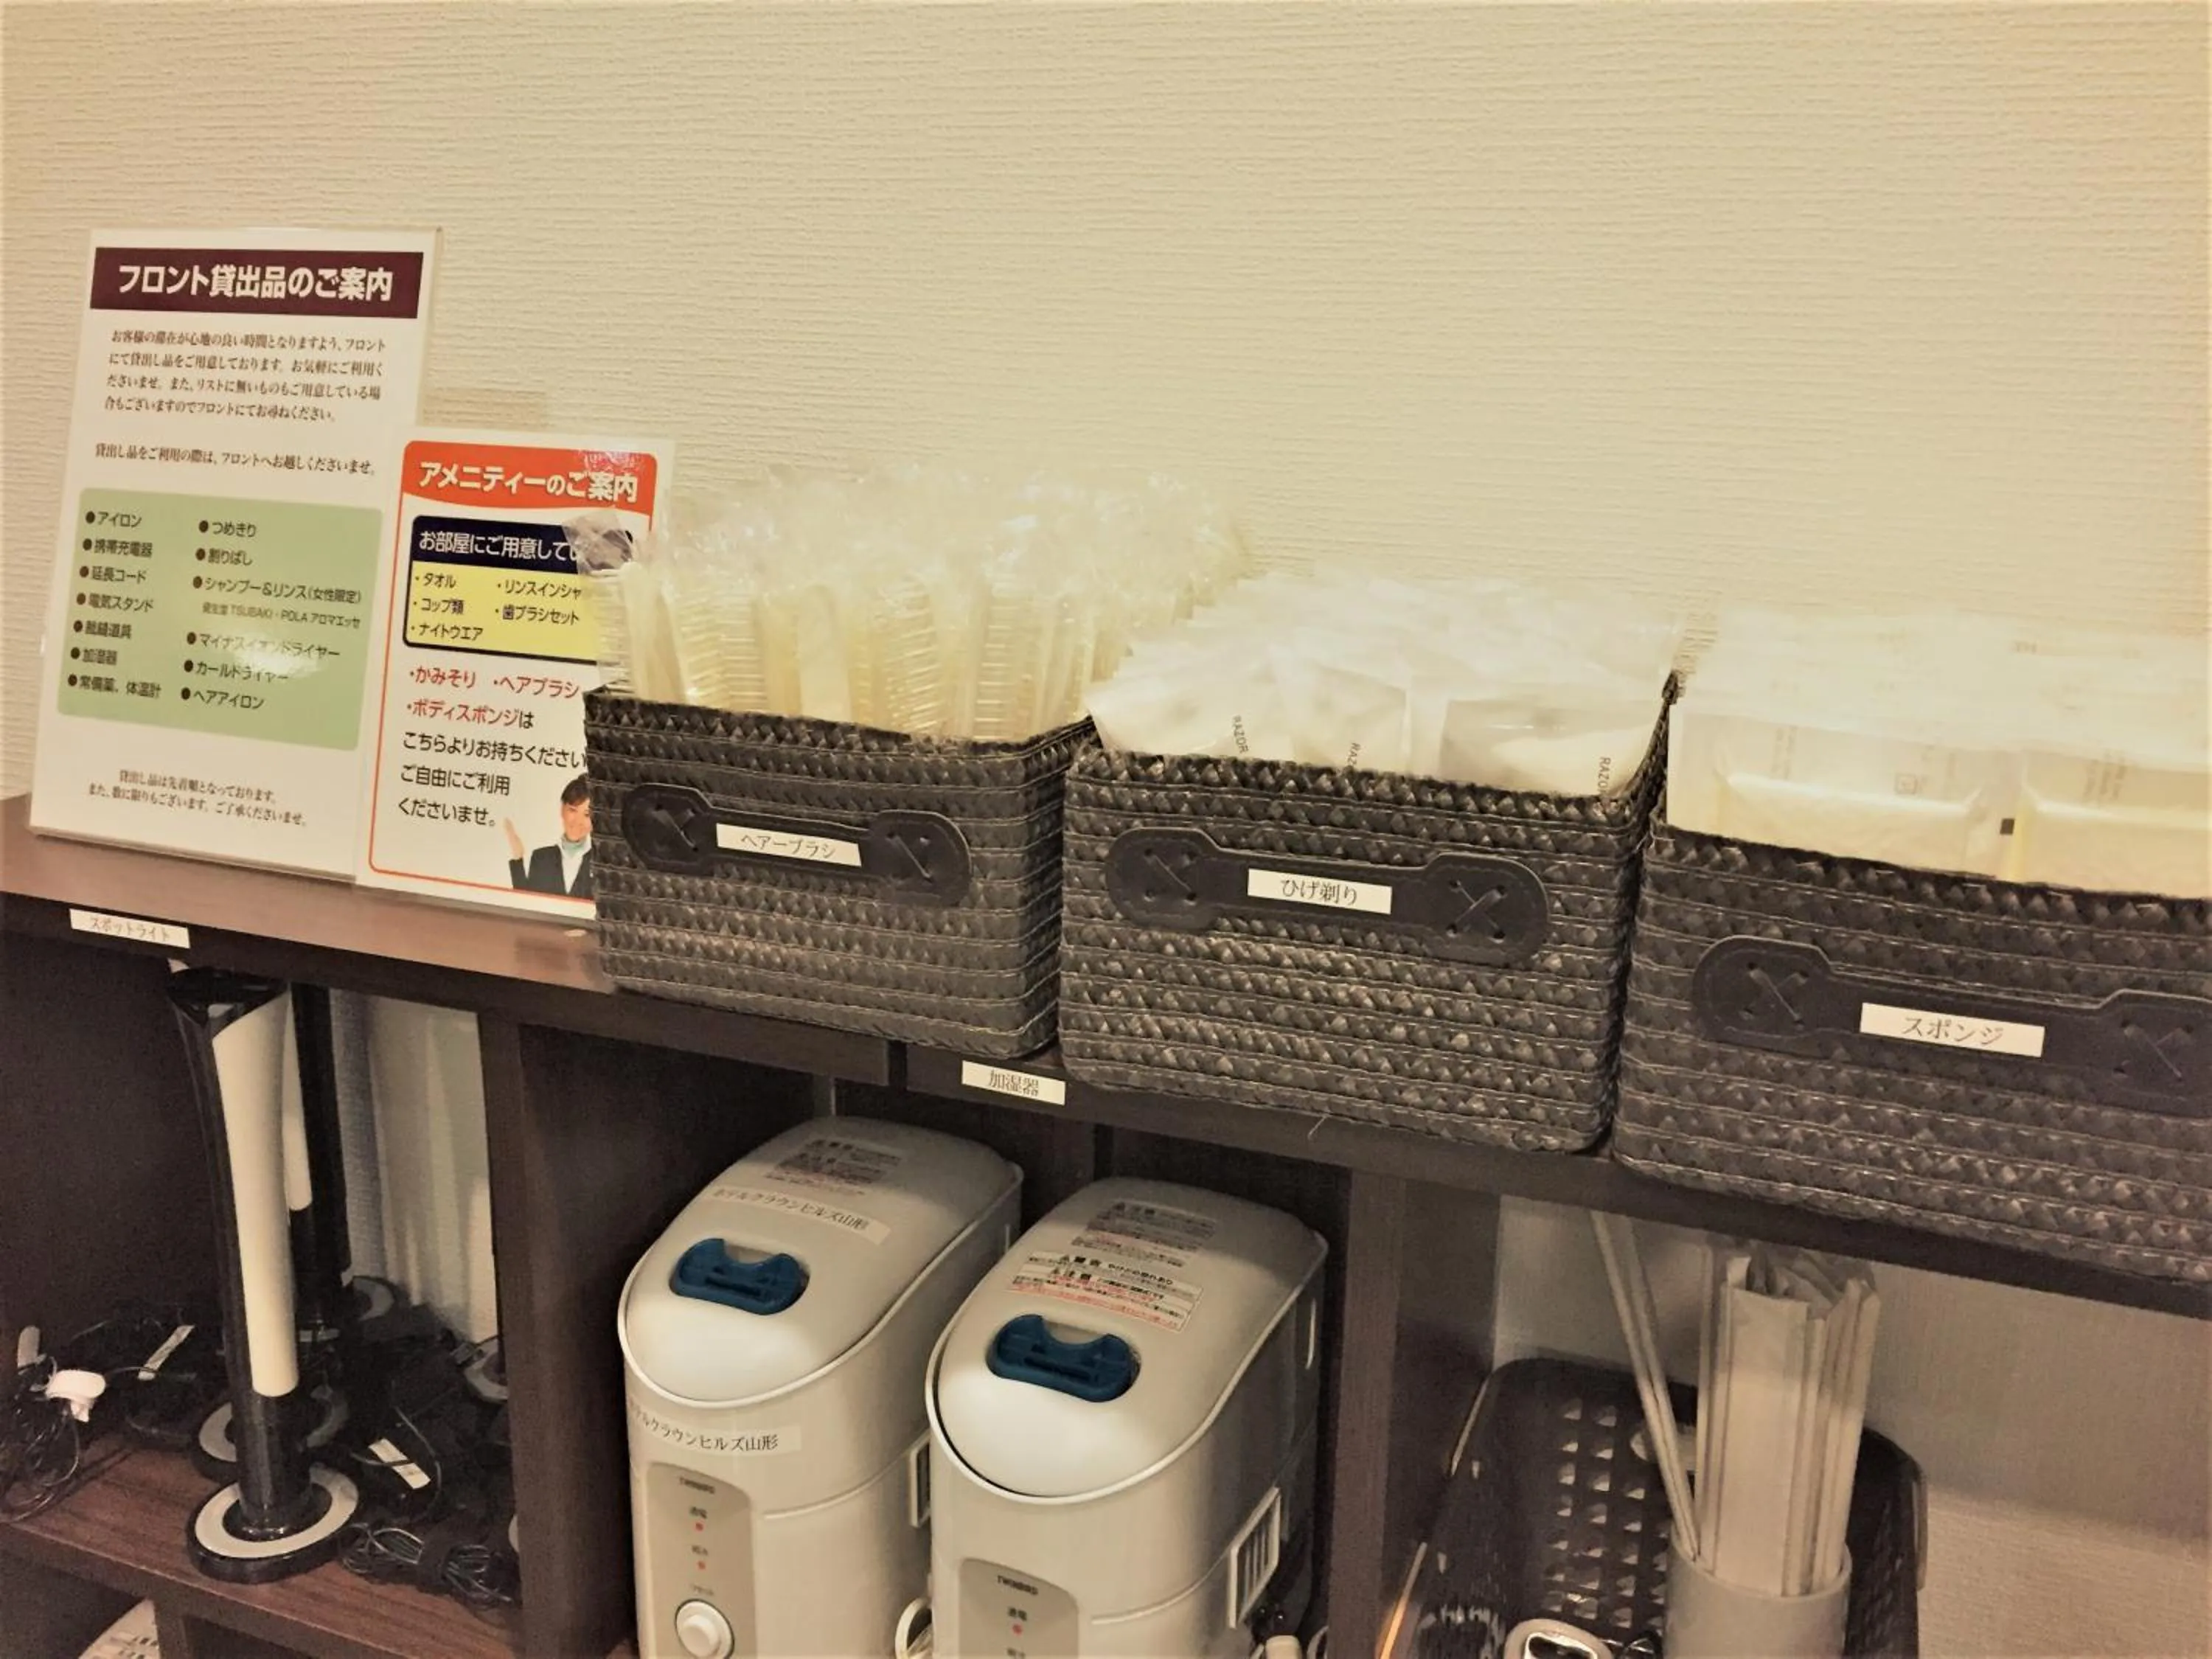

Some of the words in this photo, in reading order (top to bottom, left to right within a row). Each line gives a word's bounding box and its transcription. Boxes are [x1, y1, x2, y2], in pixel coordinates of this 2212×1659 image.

[119, 264, 394, 302] フロント貸出品のご案内
[419, 462, 639, 503] アメニティーのご案内
[97, 511, 142, 528] アイロン
[212, 521, 257, 538] つめきり
[94, 538, 153, 558] 携帯充電器
[208, 548, 253, 567] 割りばし
[91, 566, 147, 584] 延長コード
[88, 593, 153, 613] 電気スタンド
[193, 689, 264, 709] ヘアアイロン
[1232, 714, 1249, 754] RAZOR
[1347, 742, 1361, 766] RAZ
[400, 764, 510, 796] ご自由にご利用
[1598, 757, 1611, 791] RAZO
[398, 797, 496, 828] くださいませ。
[740, 834, 836, 858] ヘアーブラシ
[1281, 879, 1358, 905] ひげ剃り
[91, 917, 170, 942] スポットライト
[1901, 1017, 2004, 1046] スポンジ
[988, 1069, 1040, 1097] 加湿器
[629, 1399, 779, 1451] テルクラウンヒルズ山形
